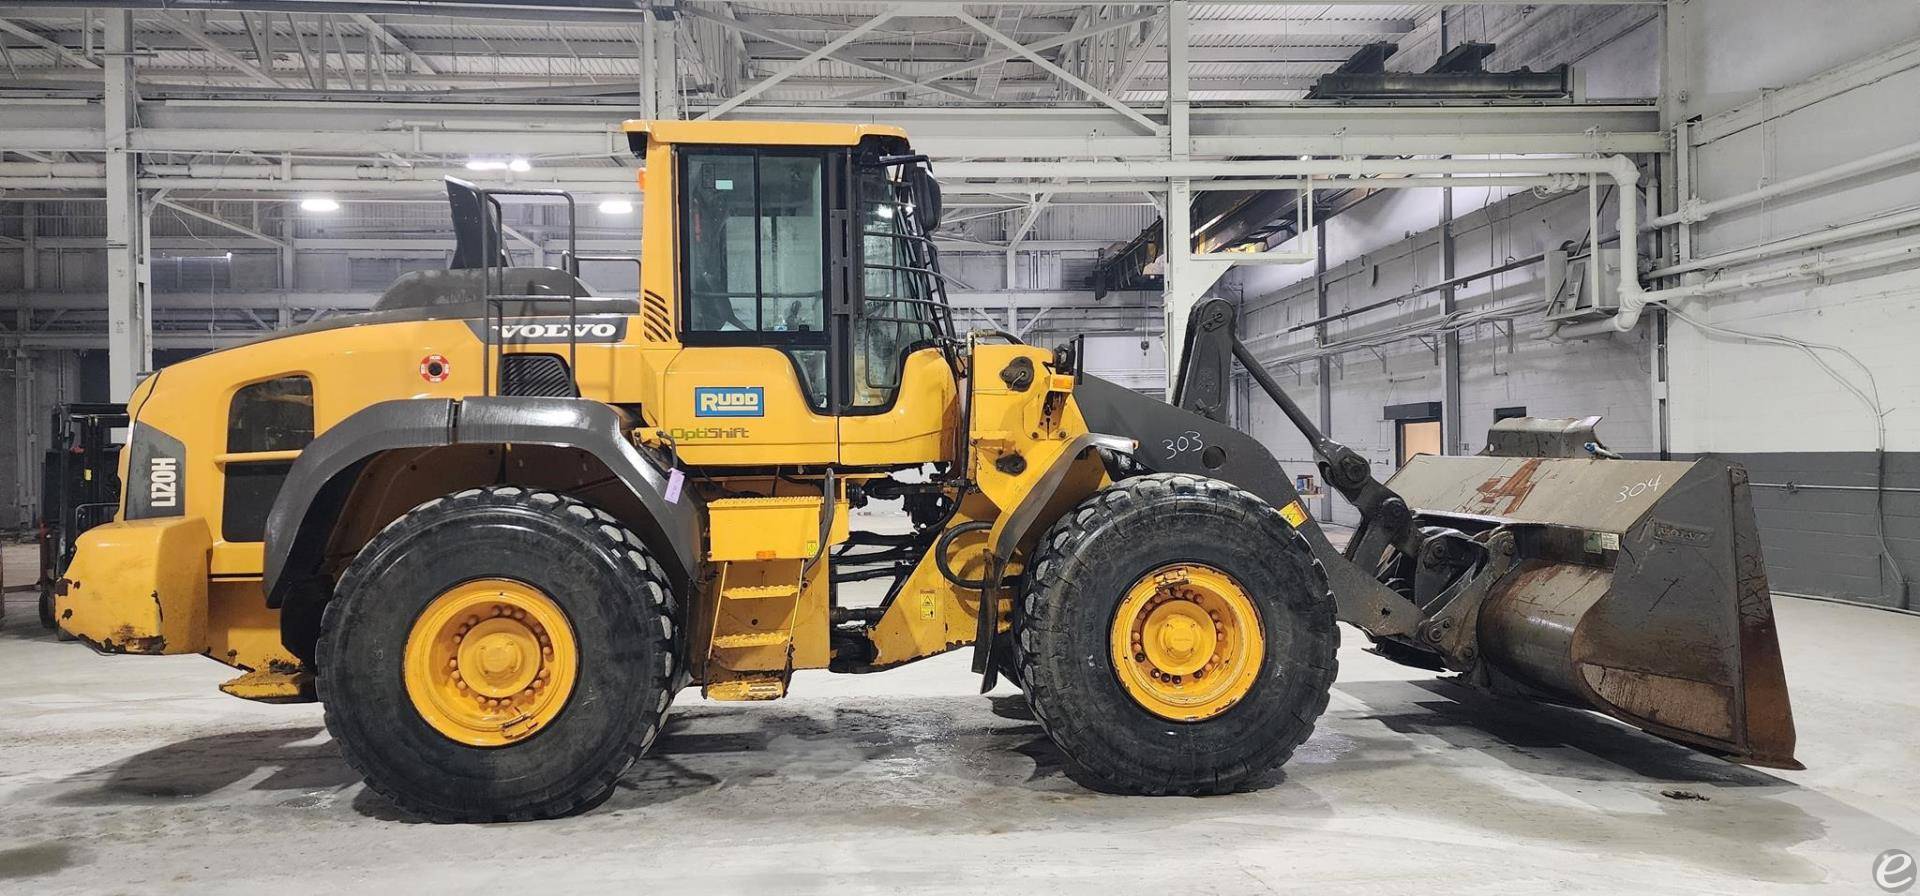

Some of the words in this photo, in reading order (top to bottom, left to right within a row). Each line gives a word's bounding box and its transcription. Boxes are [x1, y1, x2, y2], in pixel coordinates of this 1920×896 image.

[491, 324, 616, 338] VOLVO
[701, 393, 758, 411] RUDD
[671, 427, 749, 440] OptiShift
[1162, 430, 1203, 460] 303
[151, 457, 176, 506] L120H
[1615, 474, 1662, 503] 304
